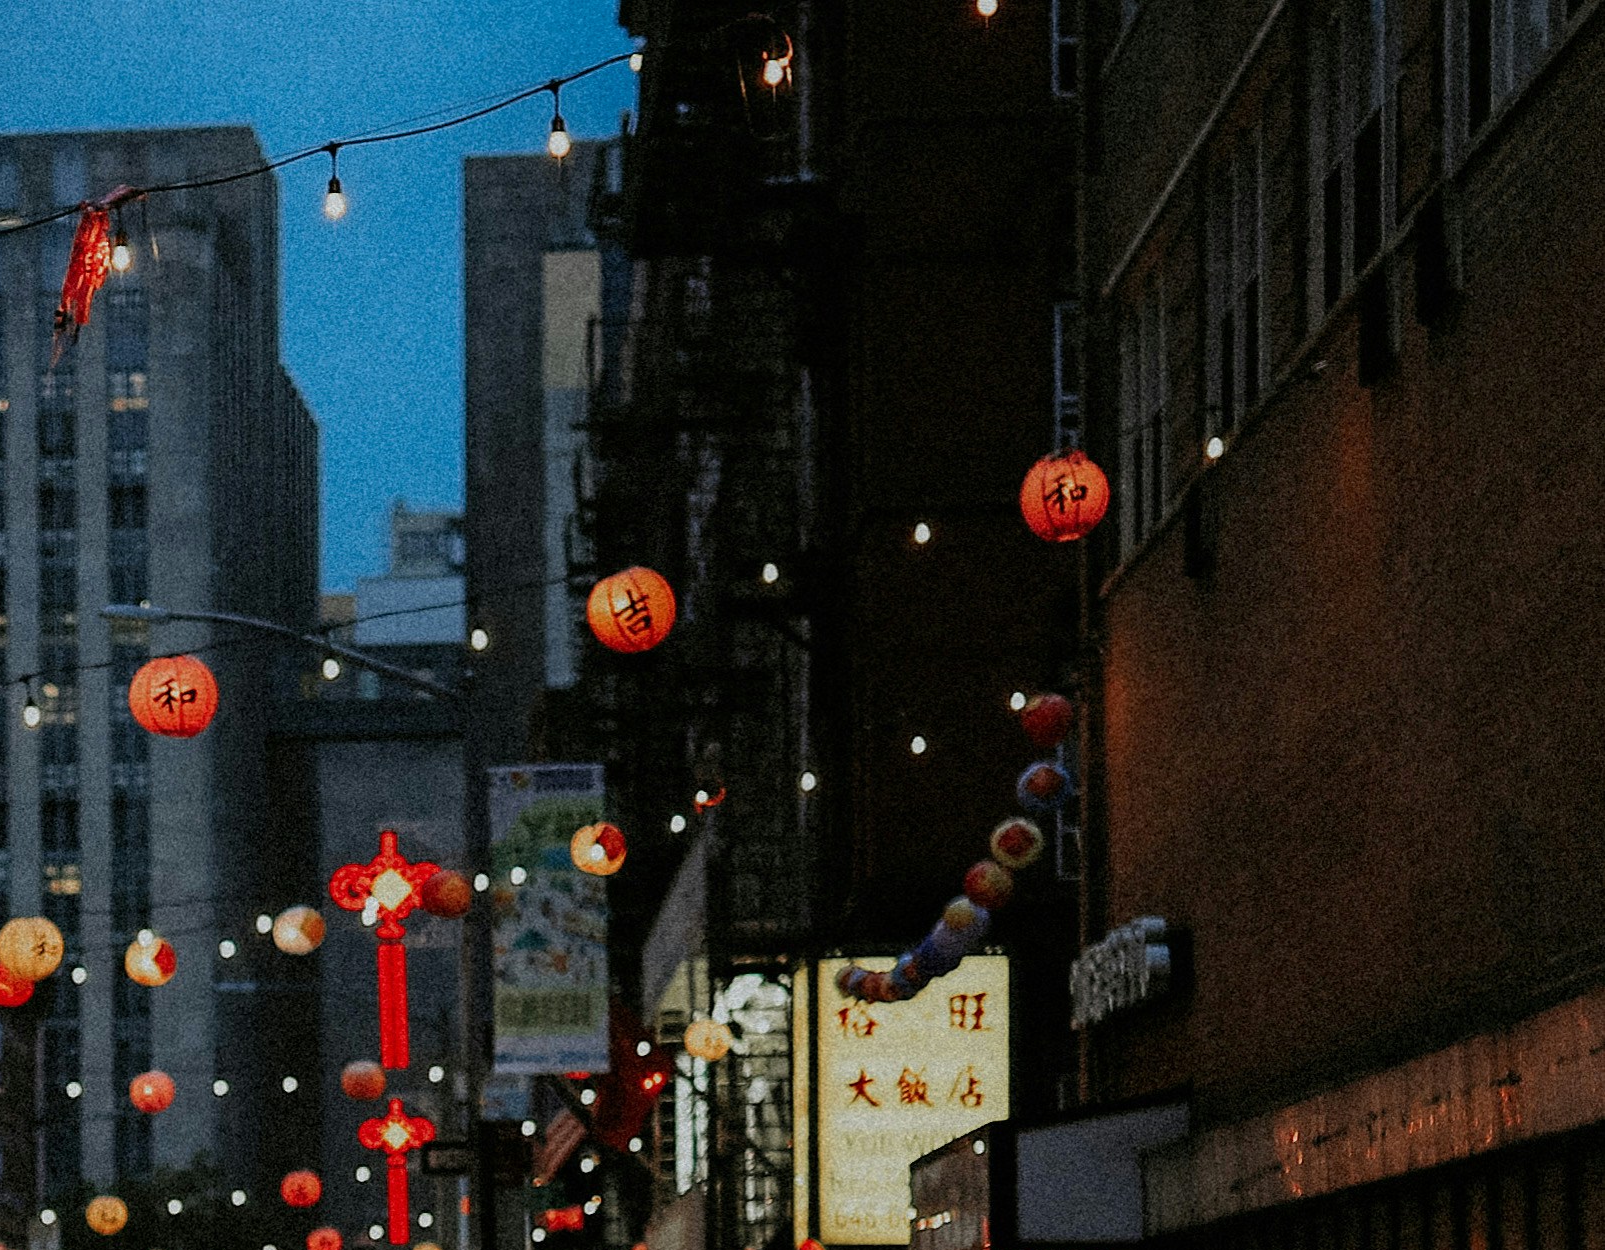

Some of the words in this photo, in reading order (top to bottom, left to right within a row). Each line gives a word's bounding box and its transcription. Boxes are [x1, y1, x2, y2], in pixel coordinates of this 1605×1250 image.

[1046, 474, 1087, 513] 和
[617, 588, 651, 636] 吉
[153, 678, 196, 712] 和
[848, 1064, 985, 1108] 大飯店
